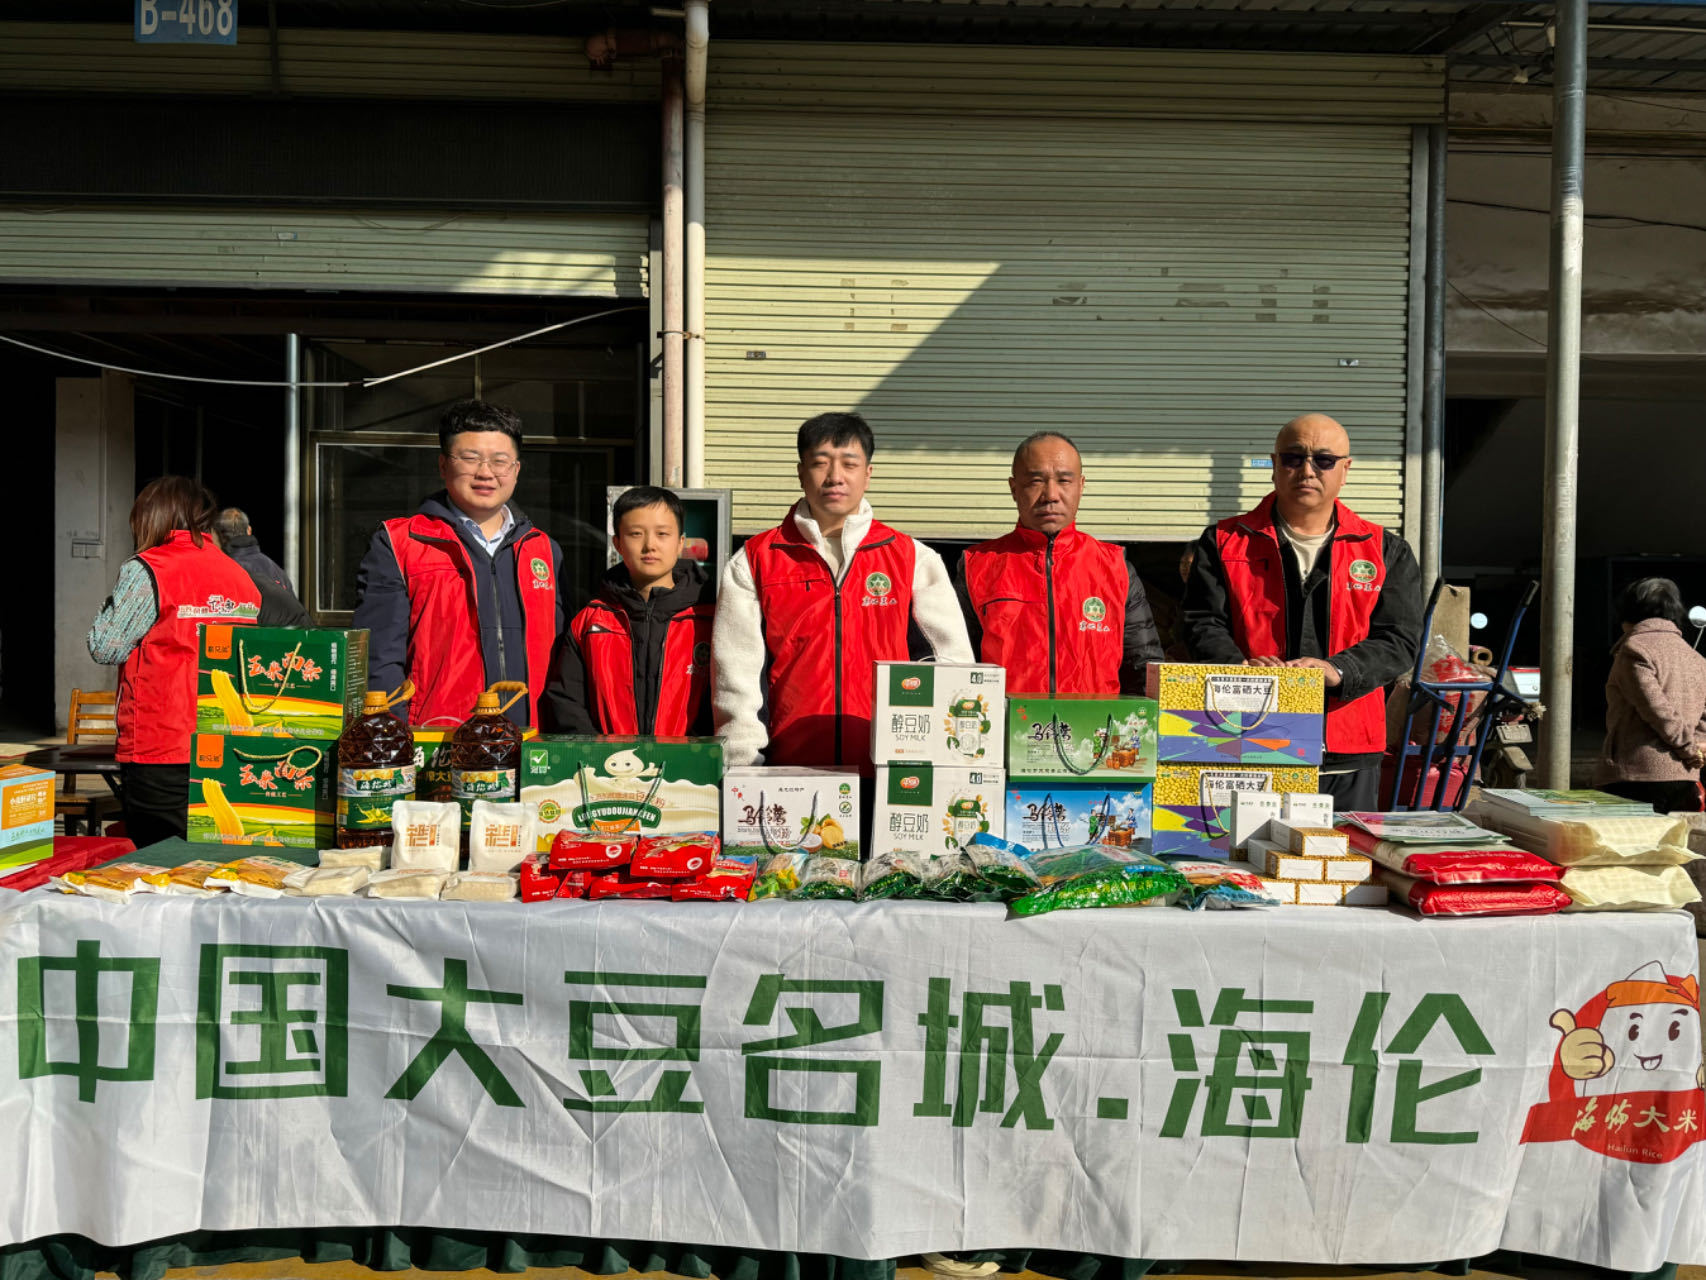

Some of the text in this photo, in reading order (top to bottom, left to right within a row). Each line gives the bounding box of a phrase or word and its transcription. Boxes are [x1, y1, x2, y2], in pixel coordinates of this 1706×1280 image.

[140, 0, 233, 36] B-468
[248, 651, 323, 682] 玉米面条
[895, 734, 926, 742] SOY MILK
[239, 760, 315, 791] 玉米面条
[893, 833, 924, 841] SOY MILK
[1607, 1143, 1663, 1159] Hailun Rice
